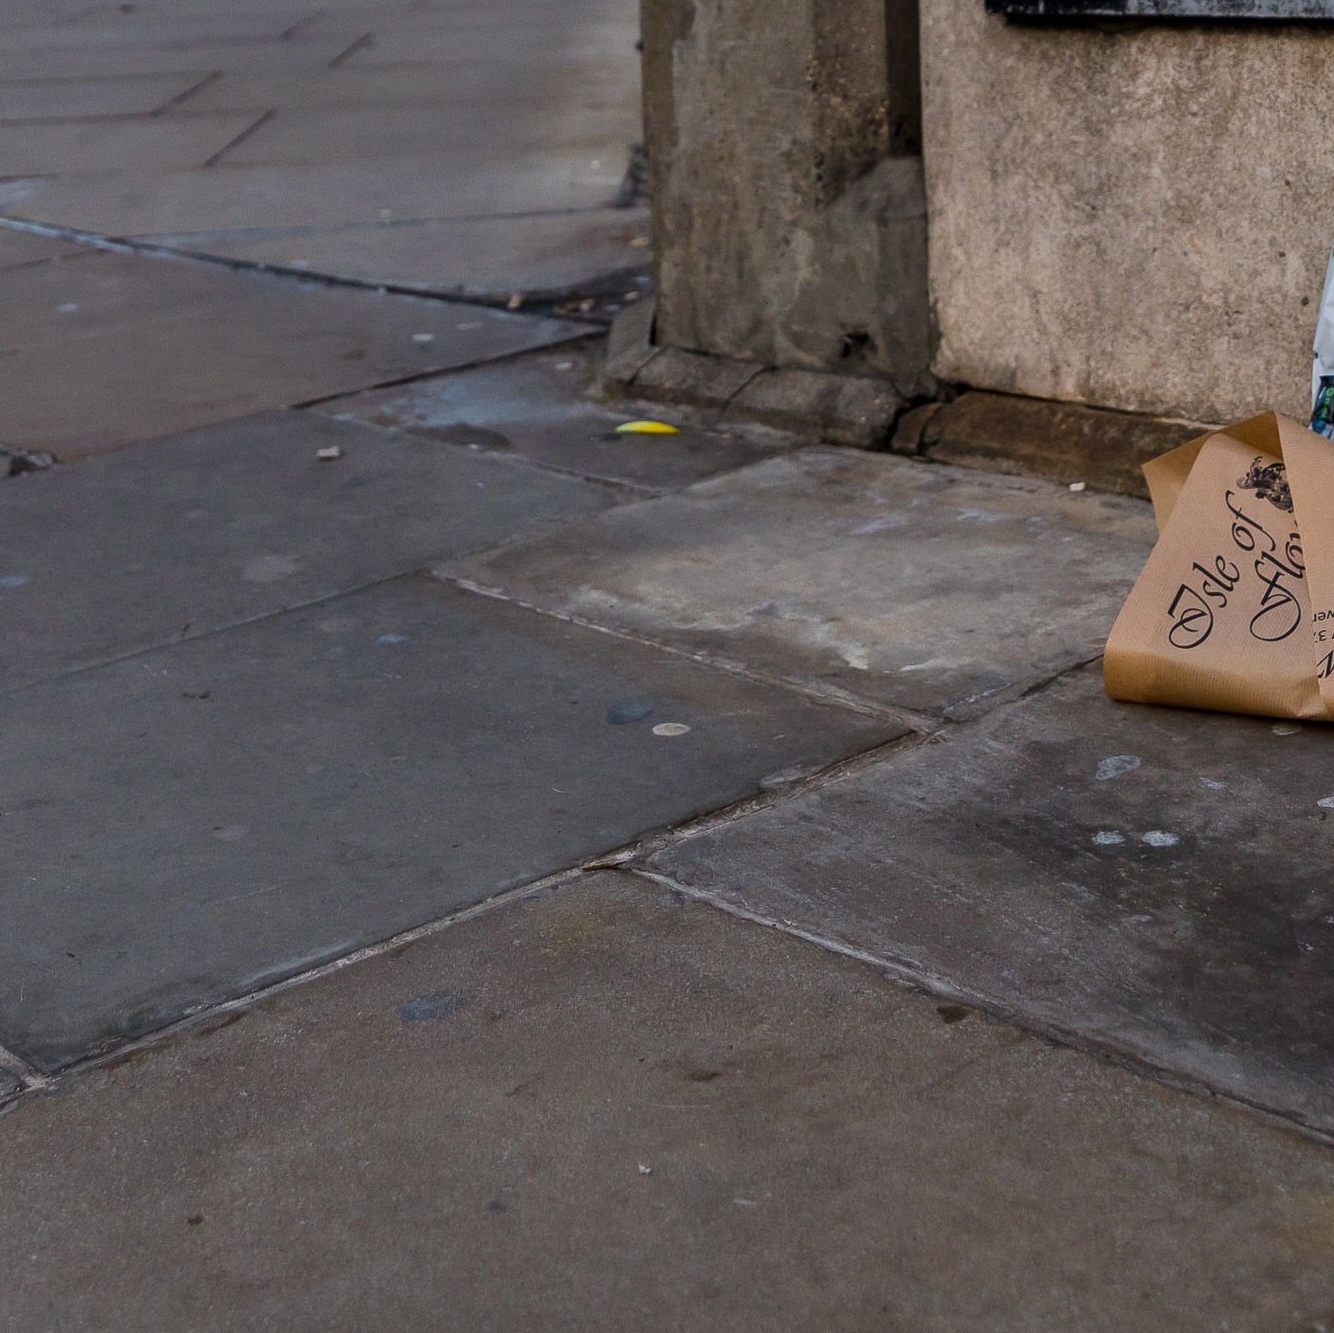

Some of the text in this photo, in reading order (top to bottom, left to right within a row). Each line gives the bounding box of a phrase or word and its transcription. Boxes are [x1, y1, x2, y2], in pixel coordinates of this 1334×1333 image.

[1167, 489, 1277, 649] Isle of
[1249, 520, 1306, 642] Flo
